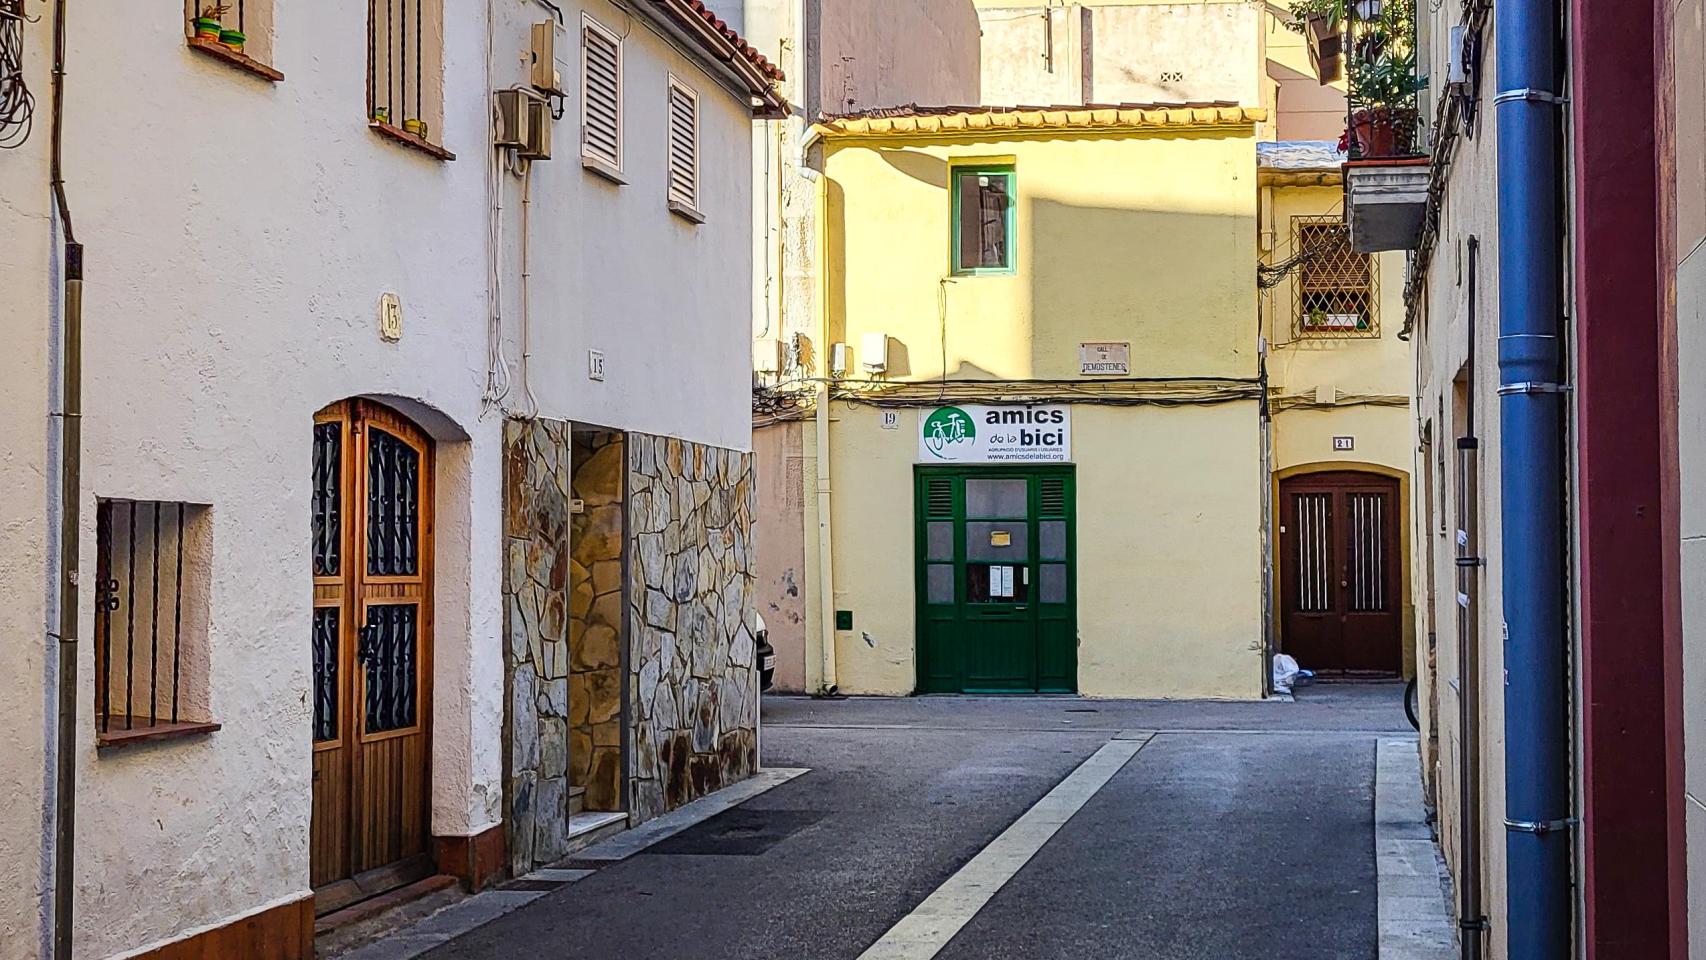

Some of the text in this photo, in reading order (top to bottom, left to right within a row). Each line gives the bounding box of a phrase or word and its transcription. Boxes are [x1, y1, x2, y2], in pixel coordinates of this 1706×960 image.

[387, 303, 398, 330] 13
[593, 358, 603, 375] 15
[885, 412, 896, 425] 19
[986, 405, 1064, 424] amics
[990, 428, 1063, 446] de la bici
[1337, 439, 1349, 448] 21
[987, 453, 1064, 461] www.amicsdelabici.org
